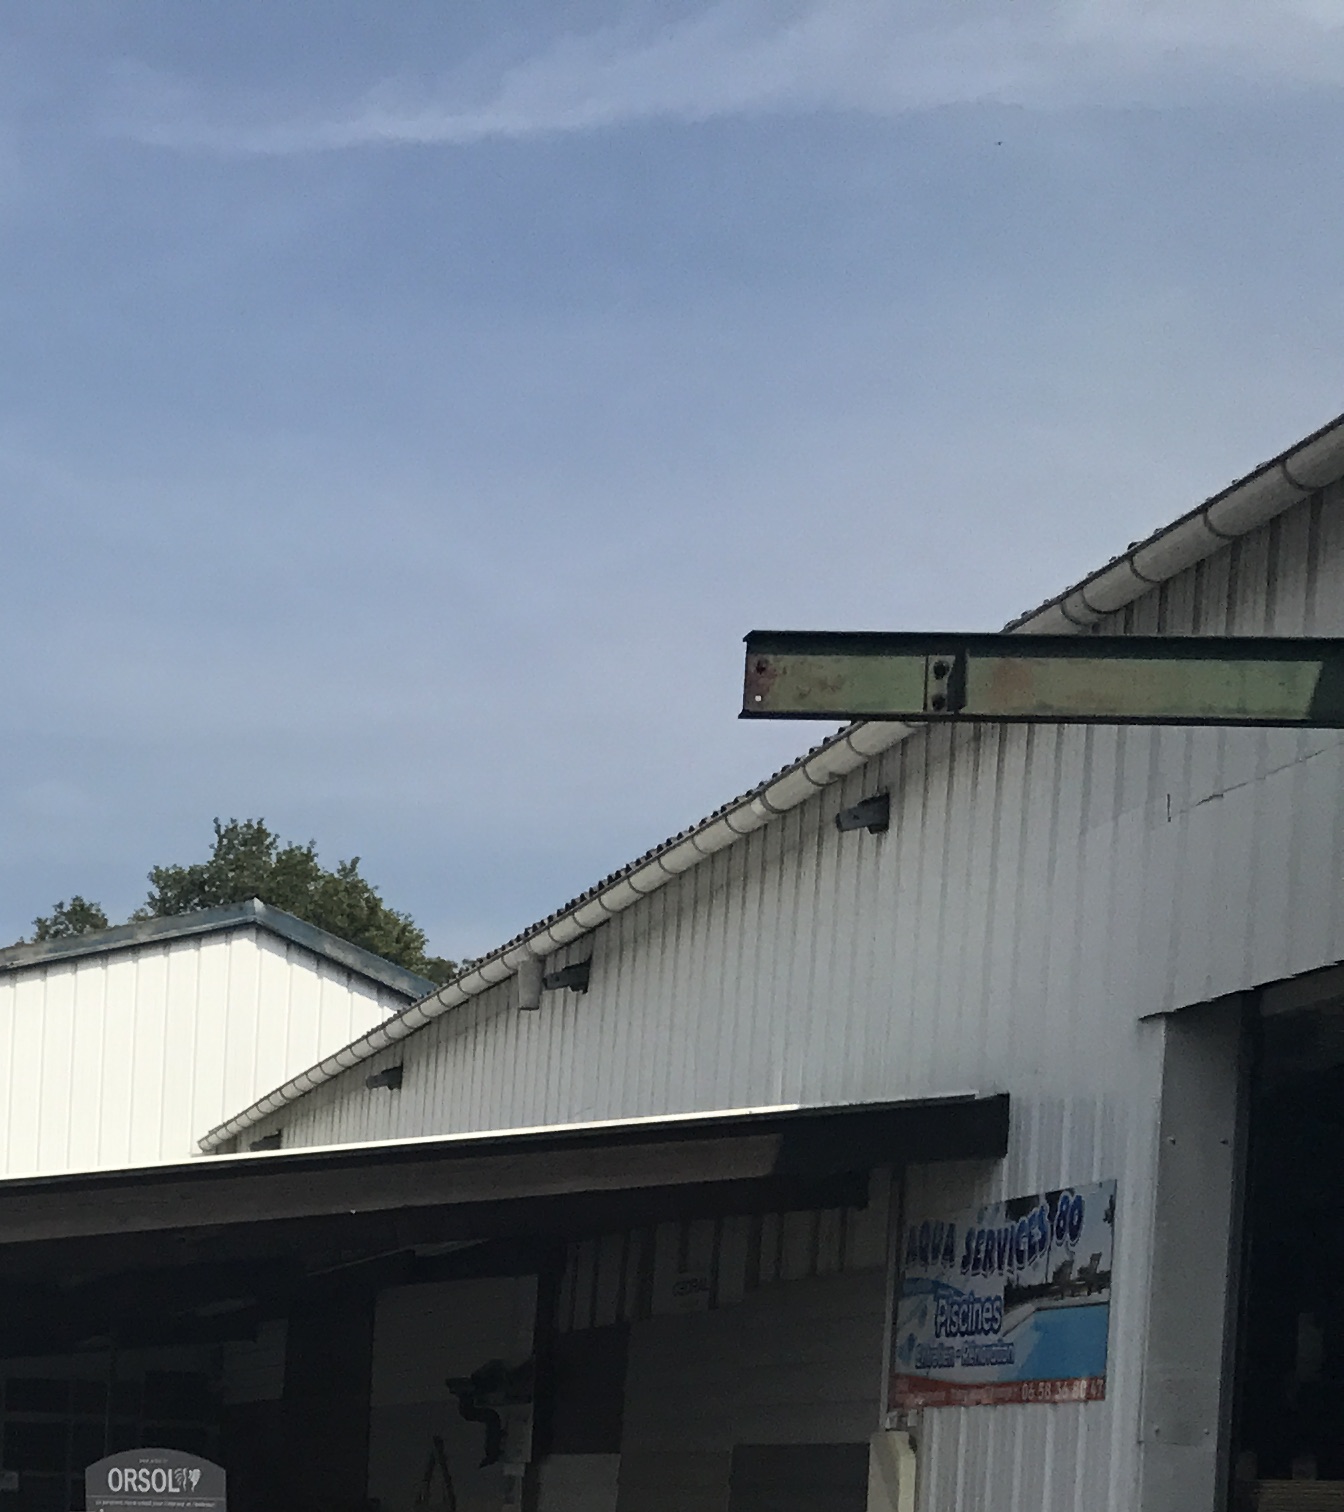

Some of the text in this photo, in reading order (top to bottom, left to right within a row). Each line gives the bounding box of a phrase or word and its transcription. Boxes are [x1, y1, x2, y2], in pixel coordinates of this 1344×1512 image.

[1054, 1190, 1085, 1247] 80
[935, 1292, 1003, 1339] Piscines
[107, 1467, 180, 1493] ORSOL
